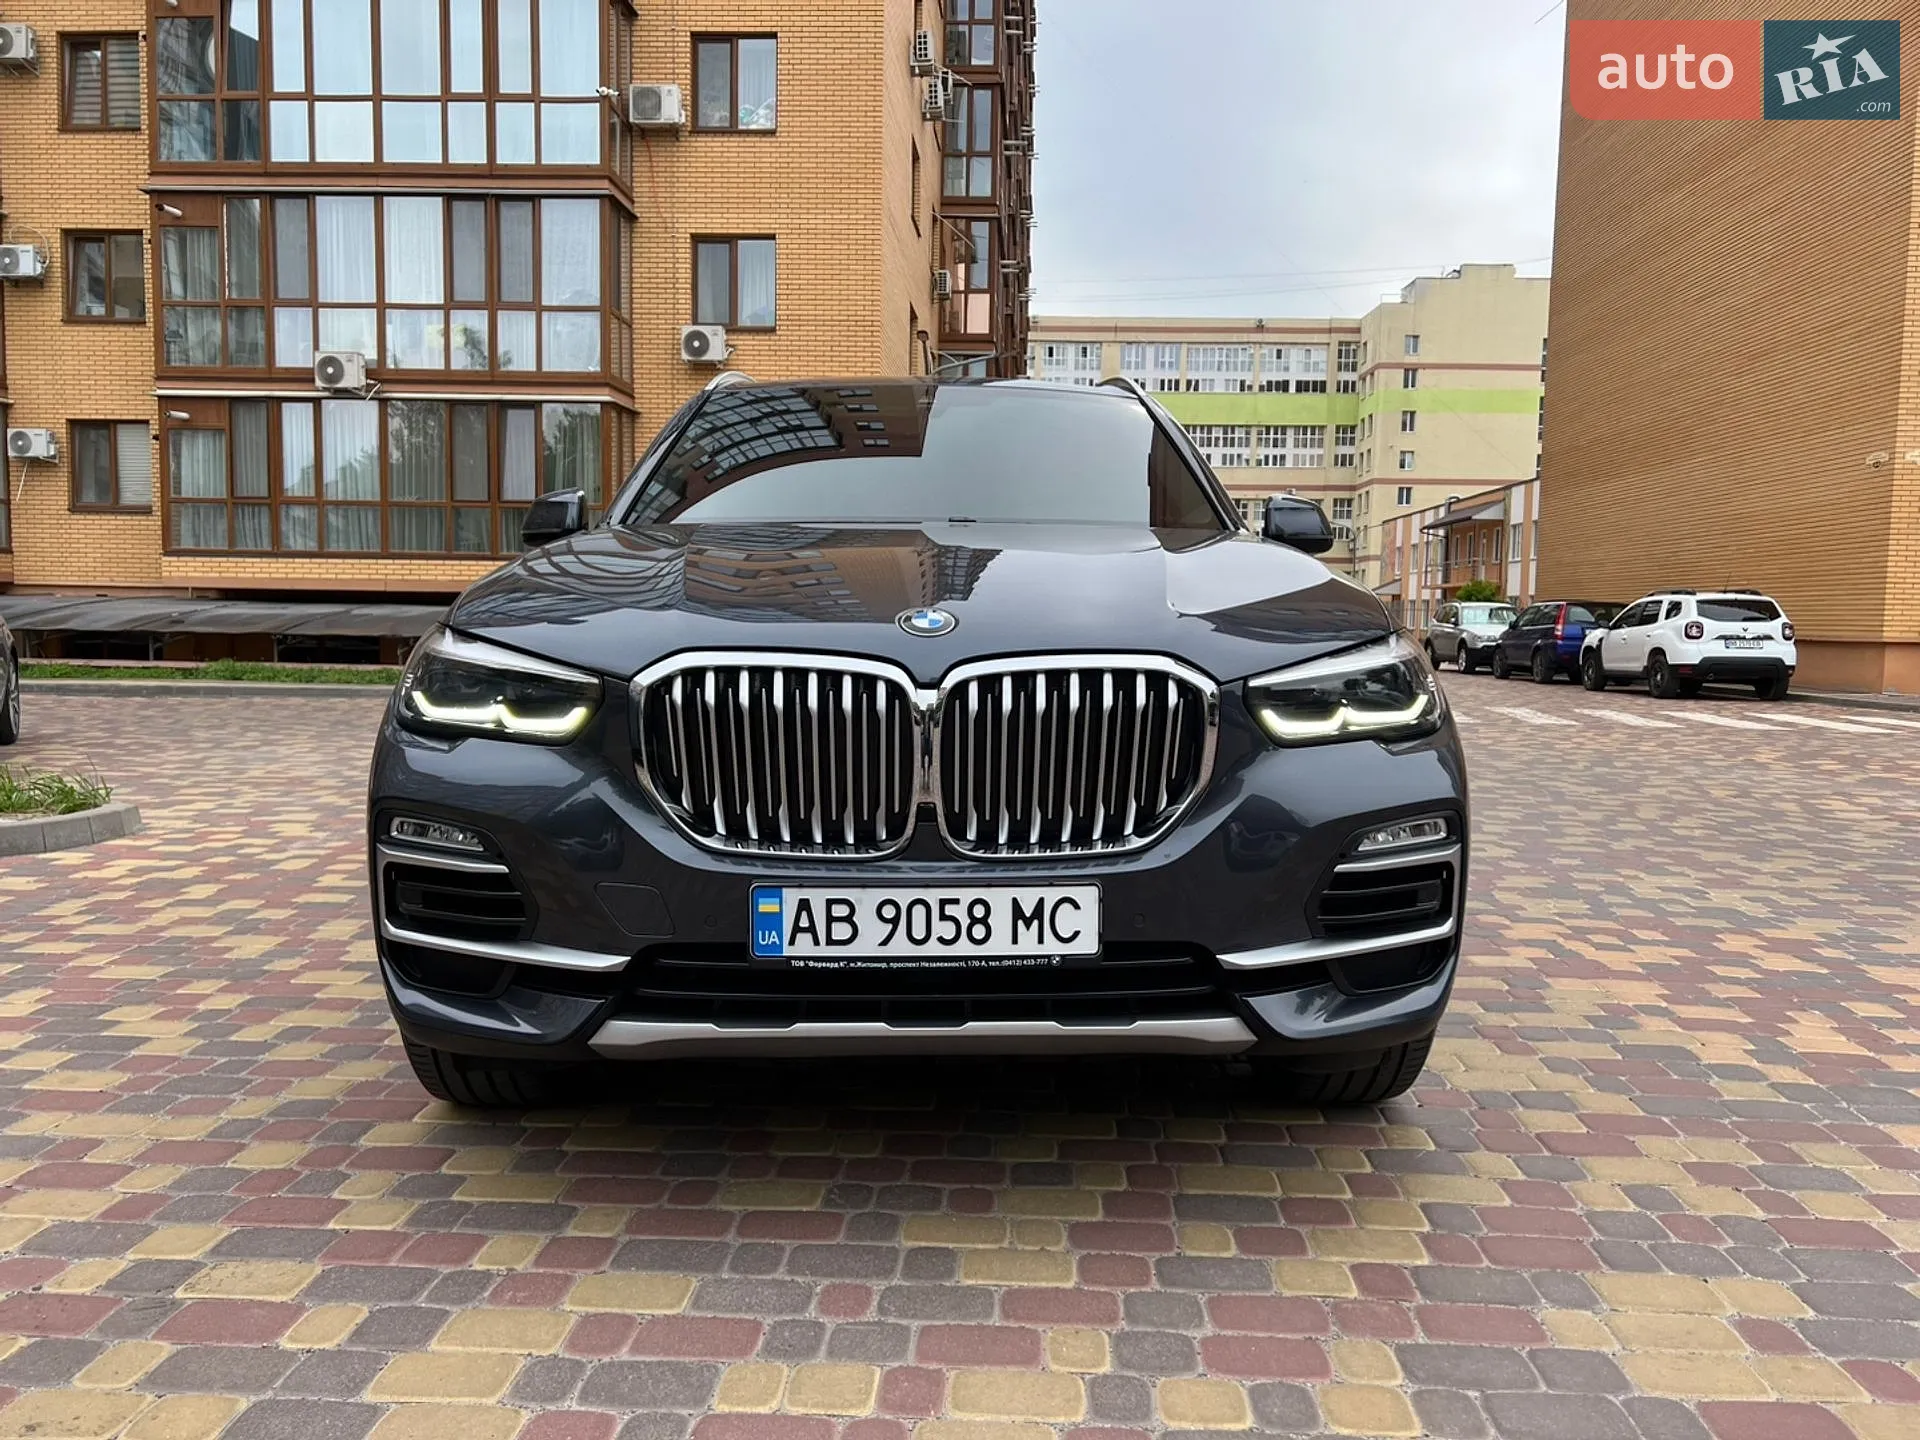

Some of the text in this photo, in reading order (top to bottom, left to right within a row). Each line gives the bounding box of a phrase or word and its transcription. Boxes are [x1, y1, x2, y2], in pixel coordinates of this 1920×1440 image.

[788, 896, 1082, 947] AB 9058 MC
[758, 930, 780, 945] UA
[1023, 958, 1048, 966] 433-777
